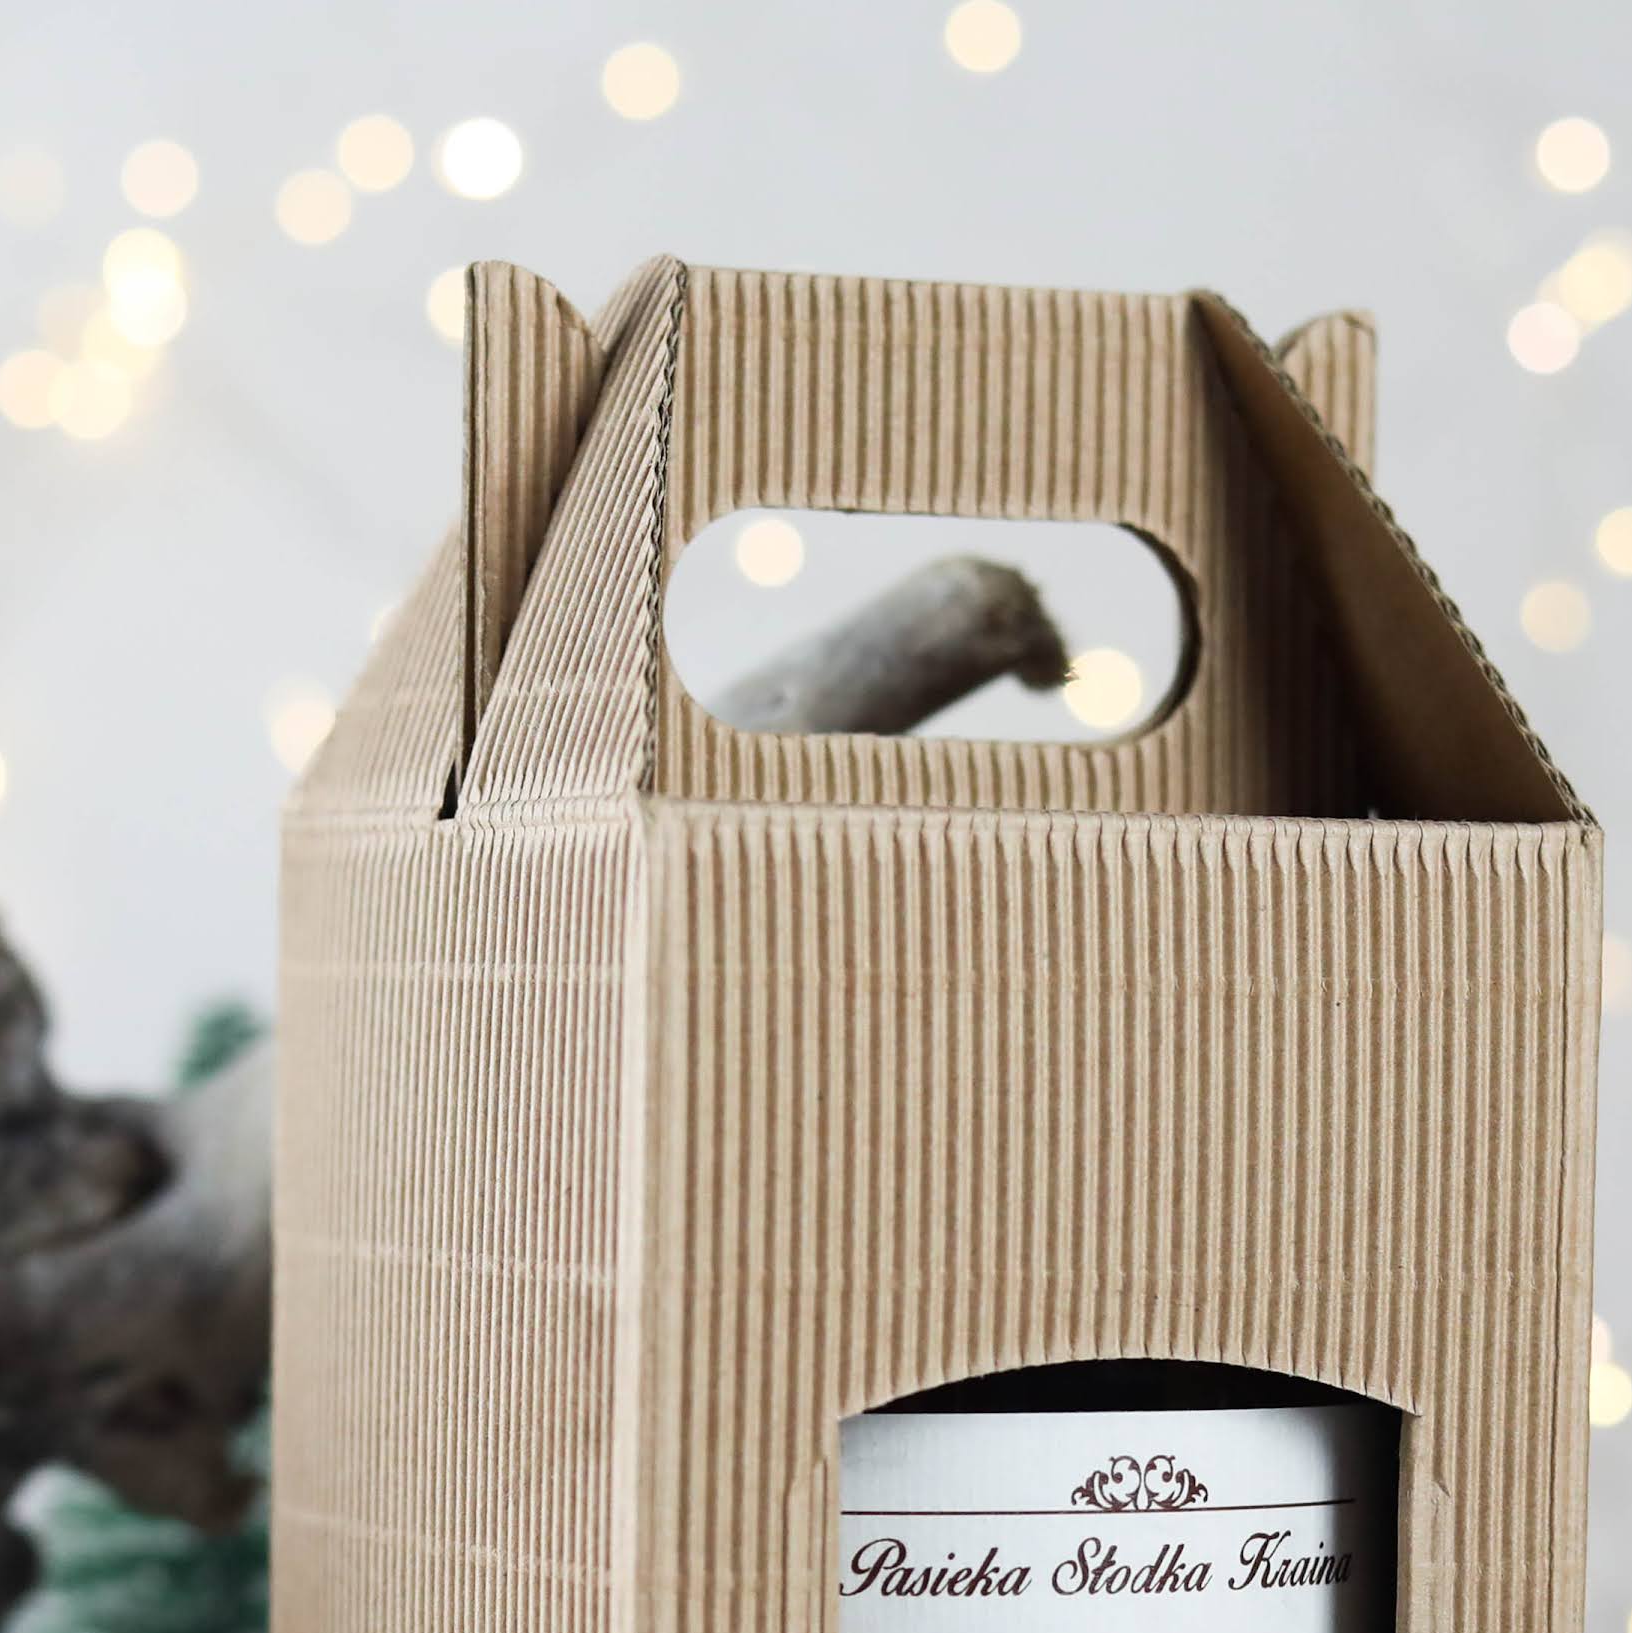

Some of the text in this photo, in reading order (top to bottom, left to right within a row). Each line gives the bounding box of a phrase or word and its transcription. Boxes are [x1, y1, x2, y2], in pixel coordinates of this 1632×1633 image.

[839, 1529, 1353, 1597] Pasieka Słodka Kraina
